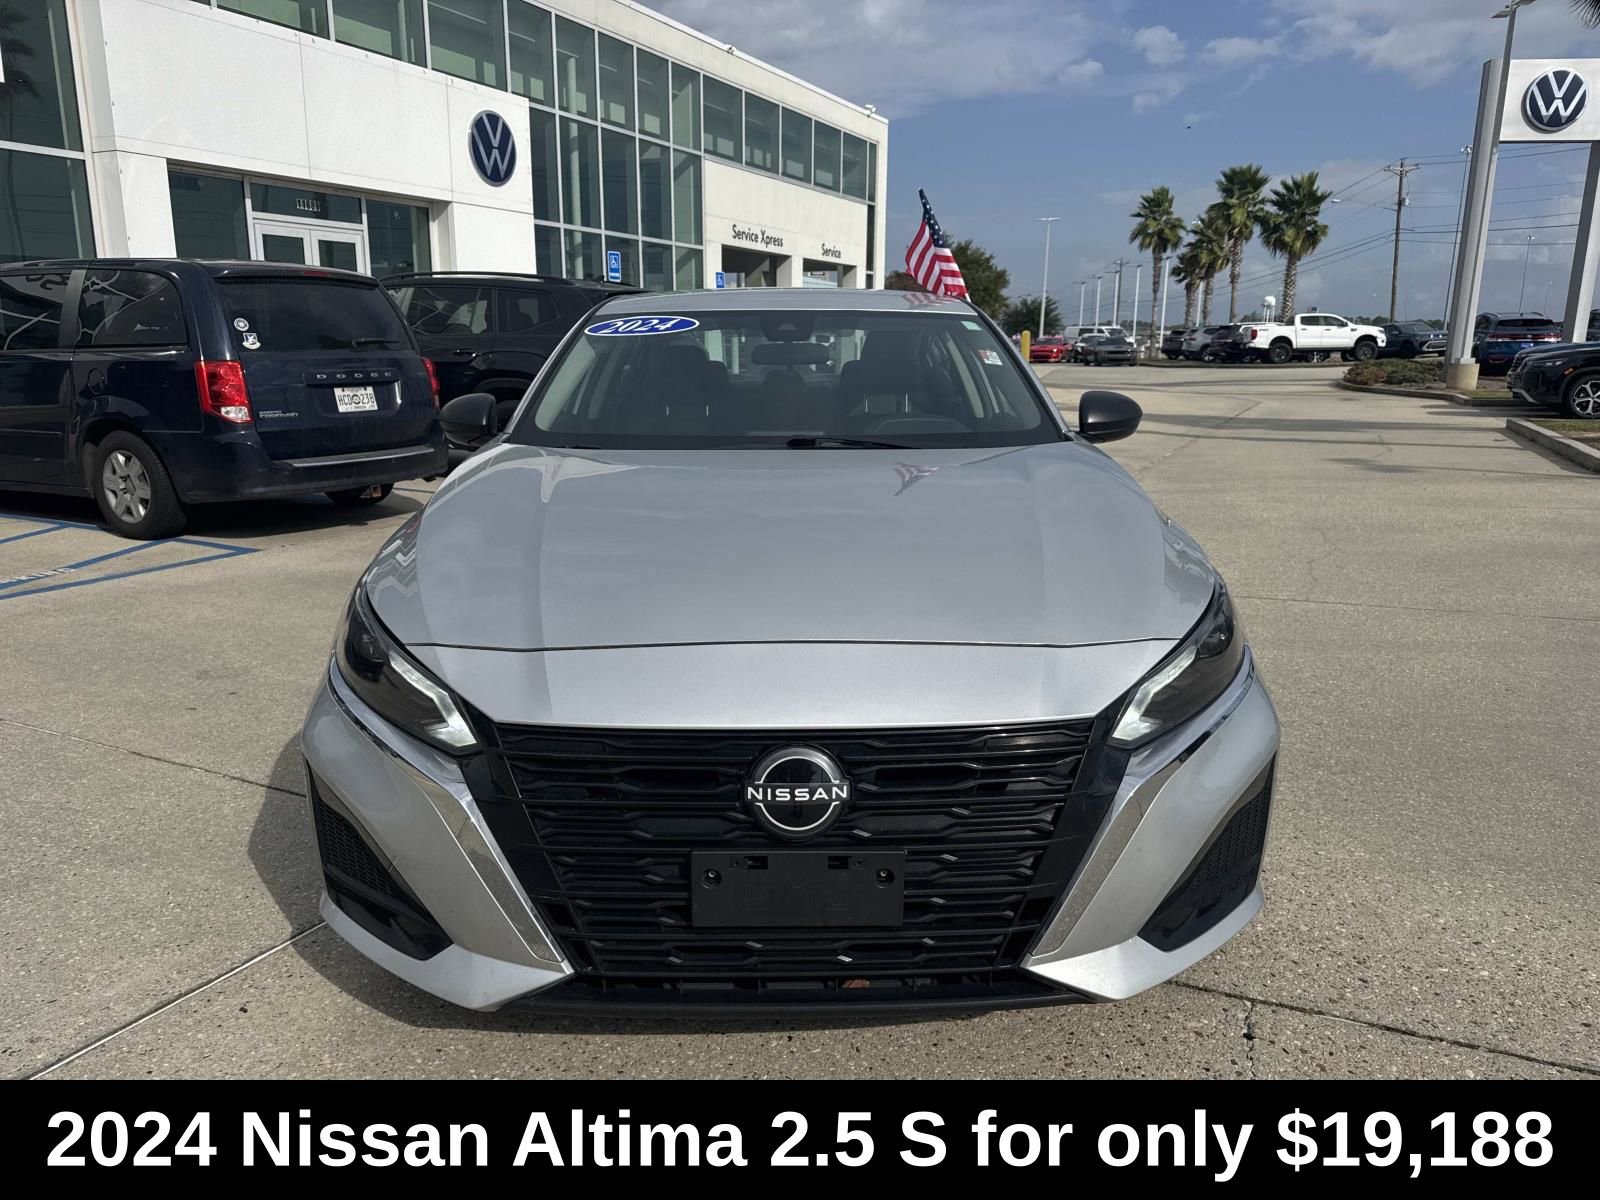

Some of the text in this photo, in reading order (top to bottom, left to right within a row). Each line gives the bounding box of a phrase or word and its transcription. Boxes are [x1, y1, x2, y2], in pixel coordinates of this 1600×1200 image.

[1529, 70, 1587, 126] VW
[471, 111, 515, 180] VW
[732, 224, 783, 248] Service Xpress
[821, 243, 841, 259] Service
[596, 318, 681, 334] 2024
[316, 372, 391, 380] DODGE
[747, 785, 848, 801] NISSAN
